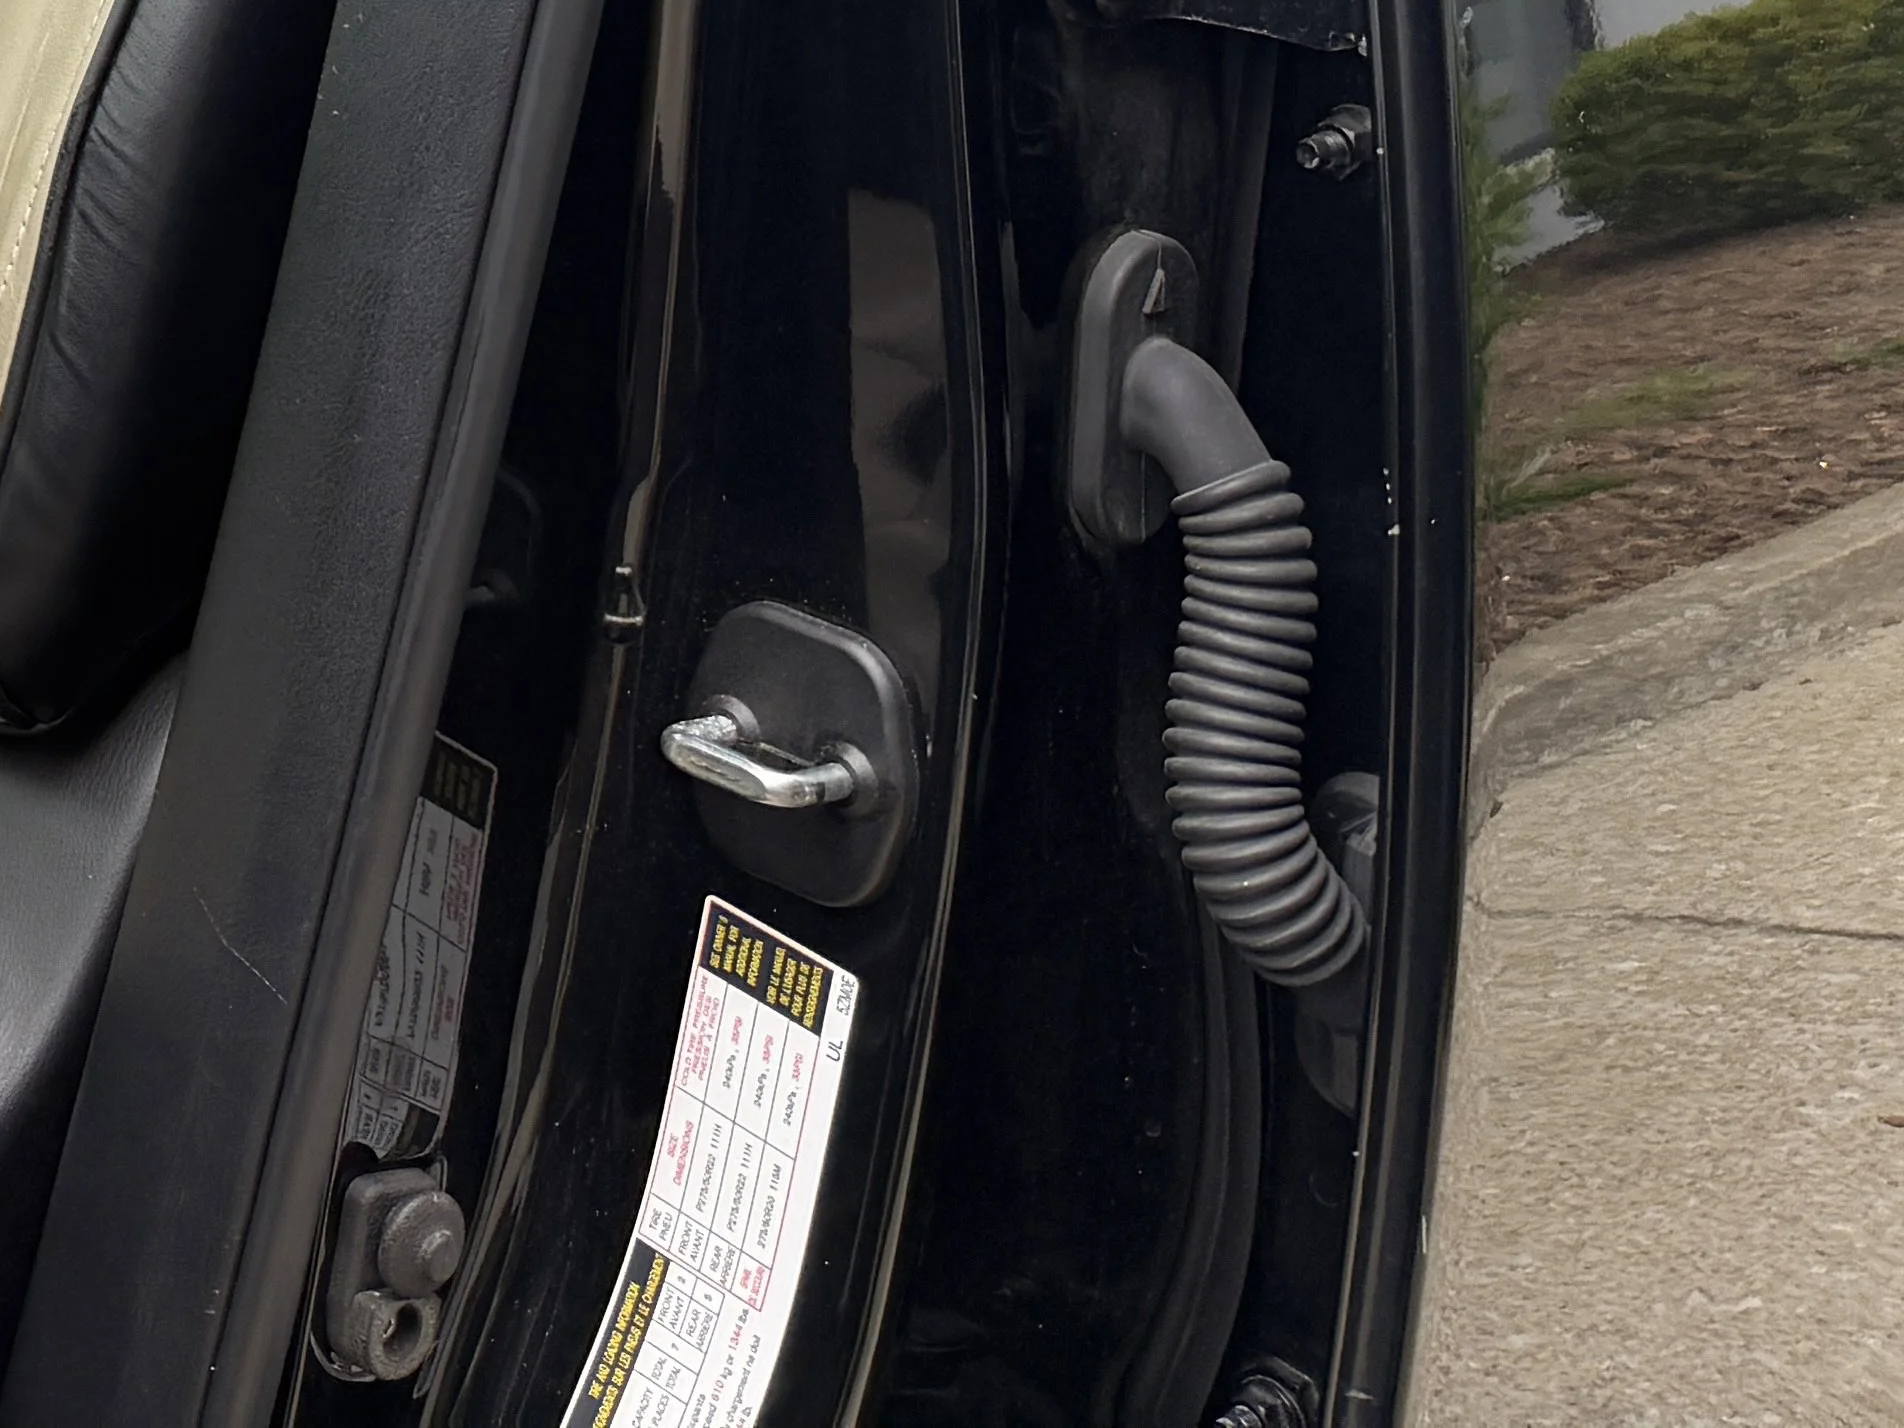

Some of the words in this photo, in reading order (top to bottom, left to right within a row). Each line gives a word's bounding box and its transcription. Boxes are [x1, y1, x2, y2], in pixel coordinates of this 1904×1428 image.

[826, 1041, 843, 1062] UL
[678, 1221, 692, 1255] FRONT
[710, 1245, 722, 1272] REAR
[658, 1287, 674, 1323] FRONT
